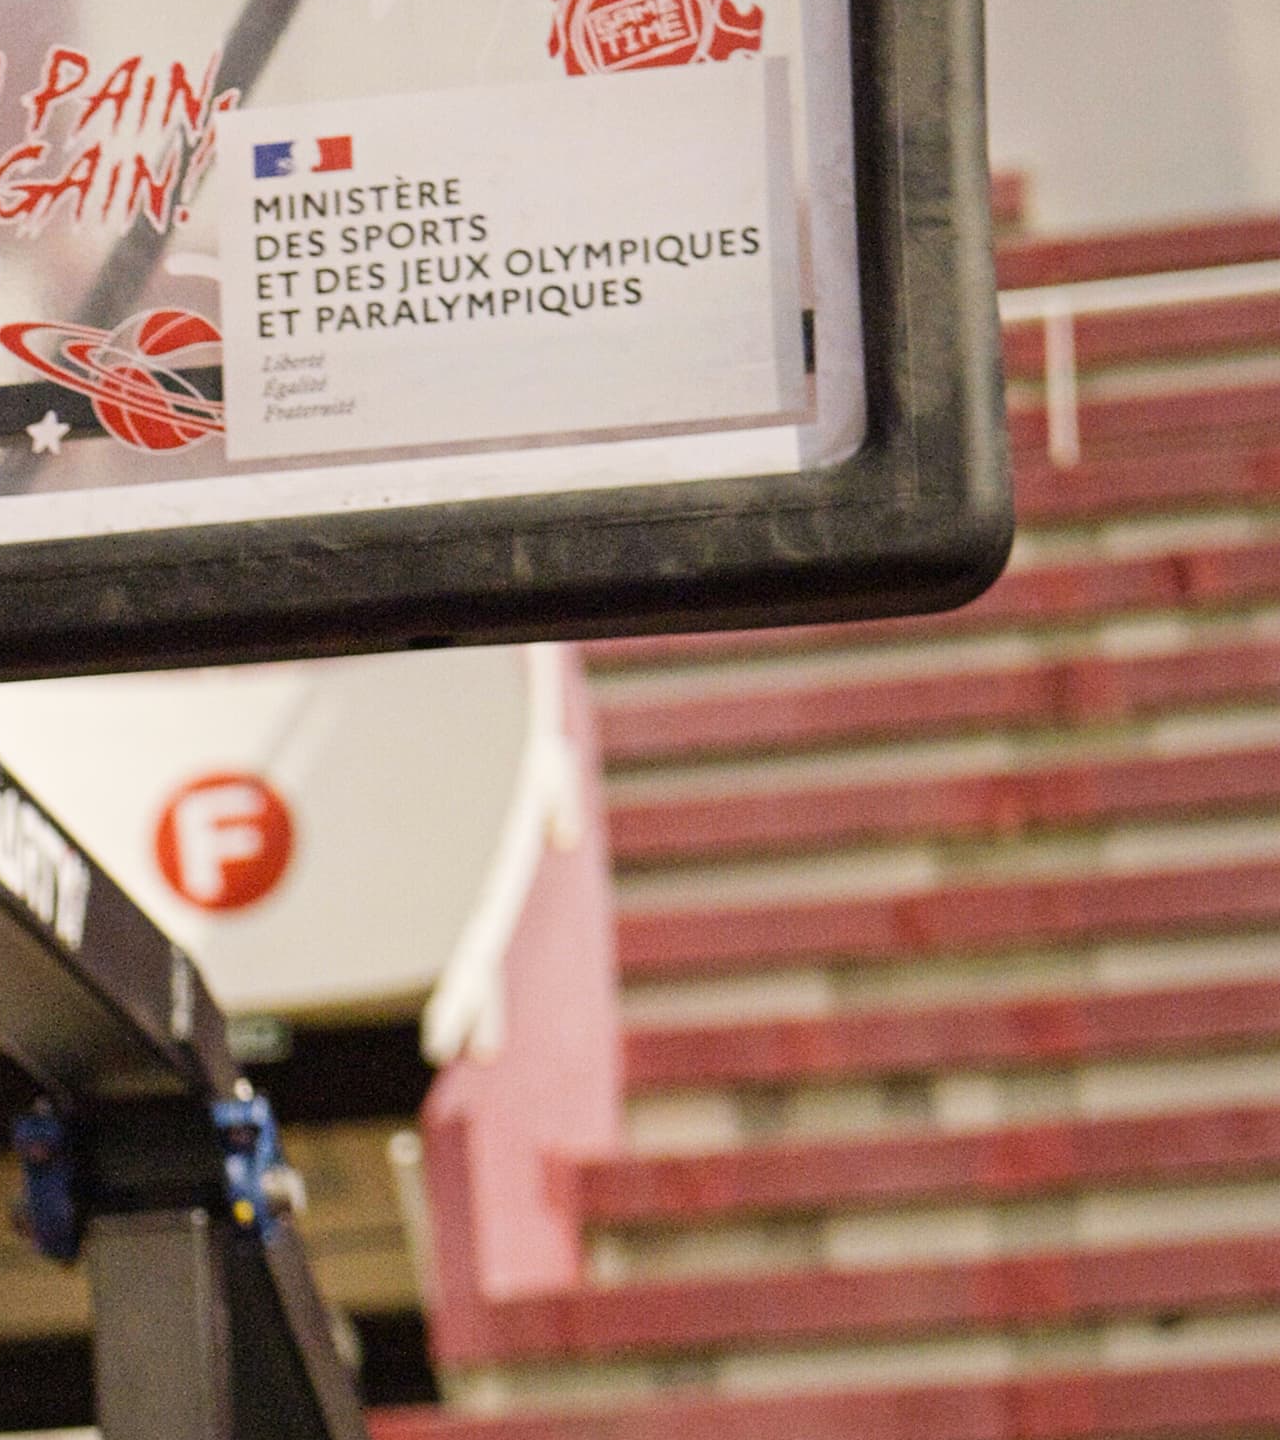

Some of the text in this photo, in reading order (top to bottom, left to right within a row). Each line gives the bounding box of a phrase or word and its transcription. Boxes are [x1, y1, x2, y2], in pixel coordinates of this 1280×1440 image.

[253, 175, 462, 224] MINISTÈRE
[255, 213, 489, 262] DES SPORTS
[256, 226, 762, 301] ET DES JEUX OLYMPIQUES
[257, 277, 644, 340] ET PARALYMPIQUES
[175, 780, 267, 903] F
